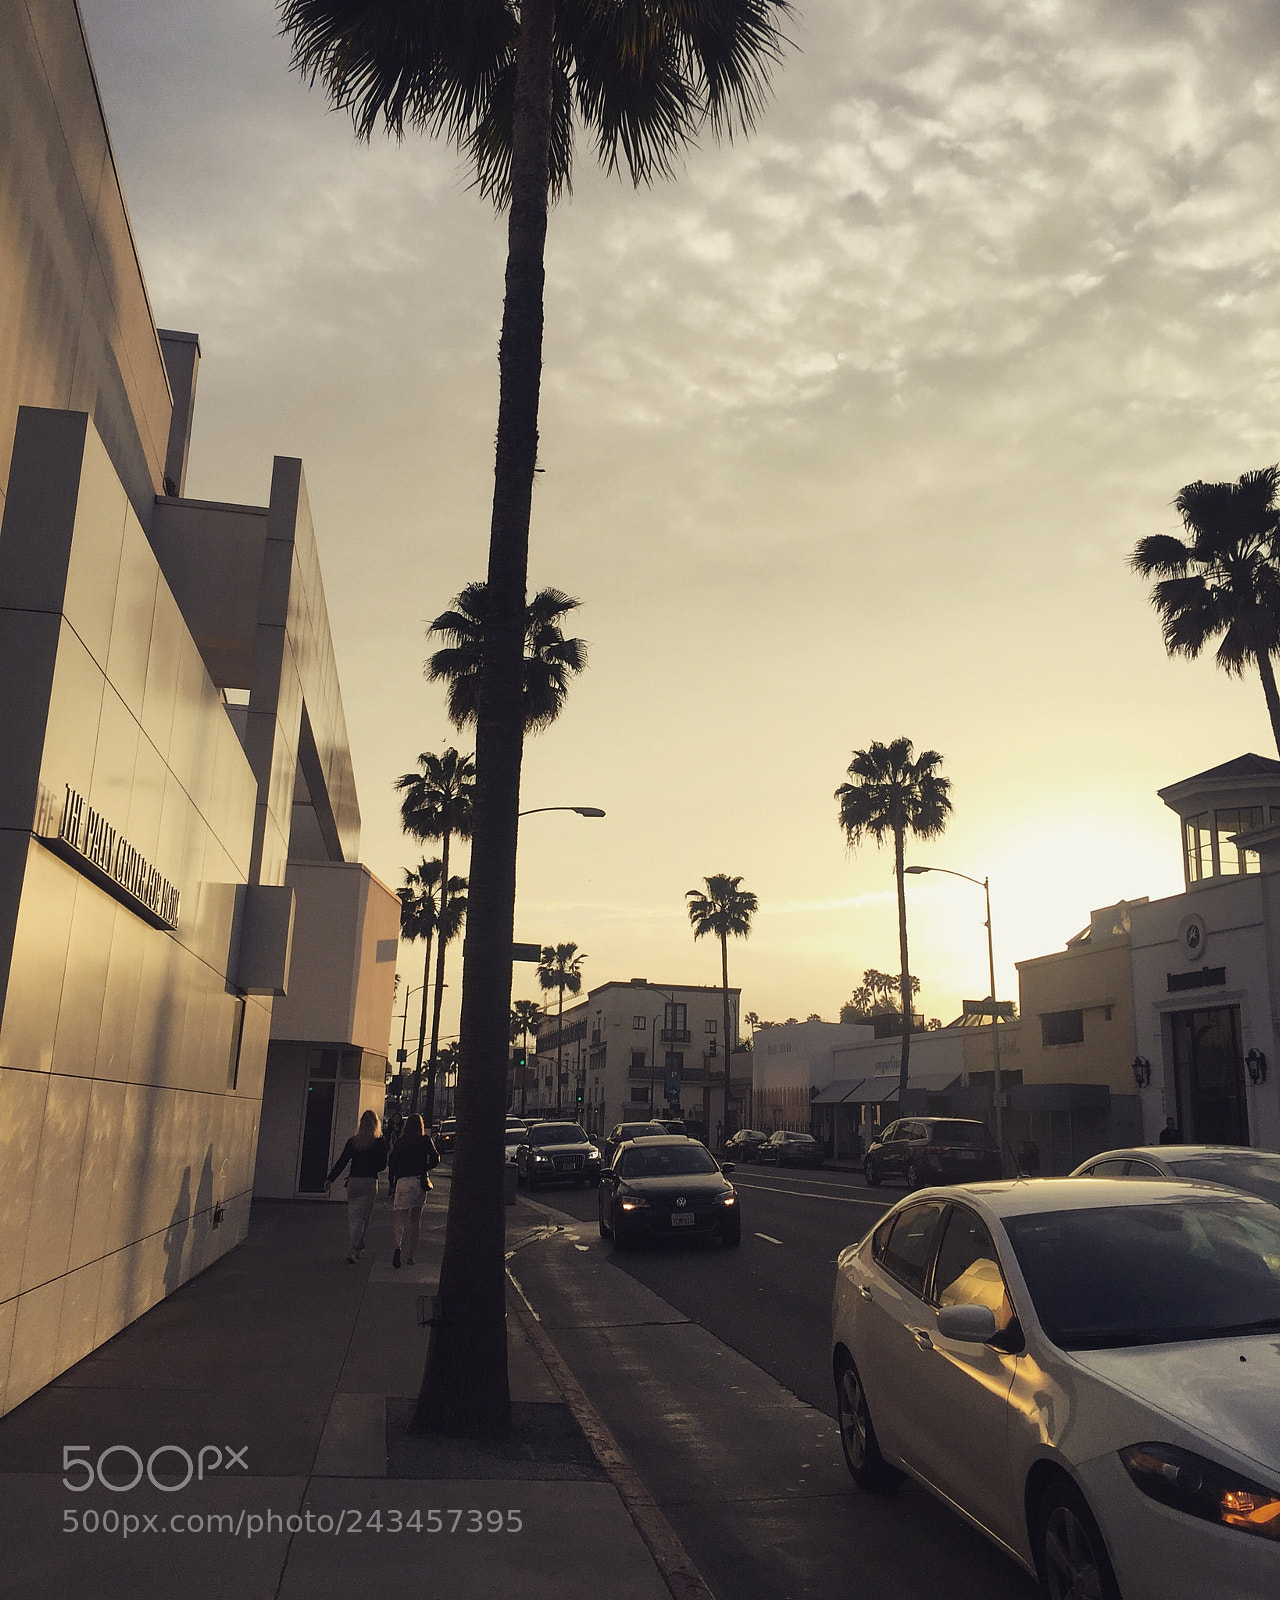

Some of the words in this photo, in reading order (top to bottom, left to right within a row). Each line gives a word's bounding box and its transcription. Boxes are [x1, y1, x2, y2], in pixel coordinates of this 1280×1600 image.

[61, 783, 86, 850] THE
[83, 806, 117, 876] PALEY
[114, 836, 148, 902] CENTER
[145, 864, 163, 912] FOR
